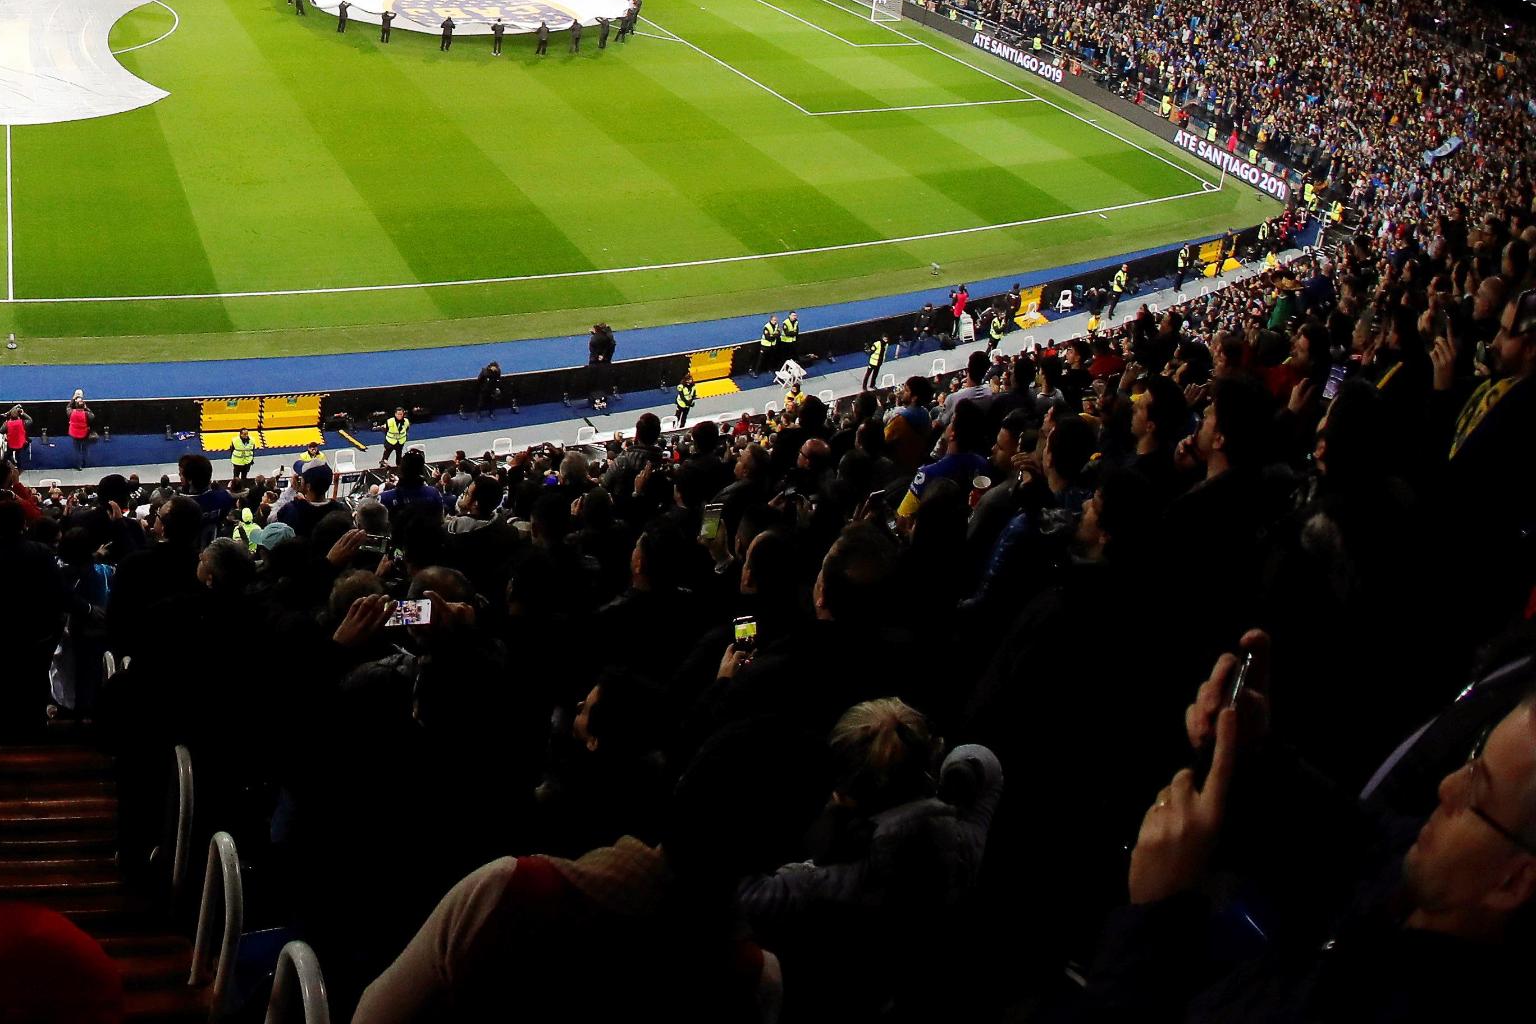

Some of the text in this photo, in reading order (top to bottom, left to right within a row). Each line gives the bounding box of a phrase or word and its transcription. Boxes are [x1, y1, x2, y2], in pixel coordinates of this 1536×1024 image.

[973, 32, 1062, 83] ATÉ SANTIAGO 2019
[1174, 129, 1197, 153] ATÉ
[1197, 140, 1260, 184] SANTIAGO
